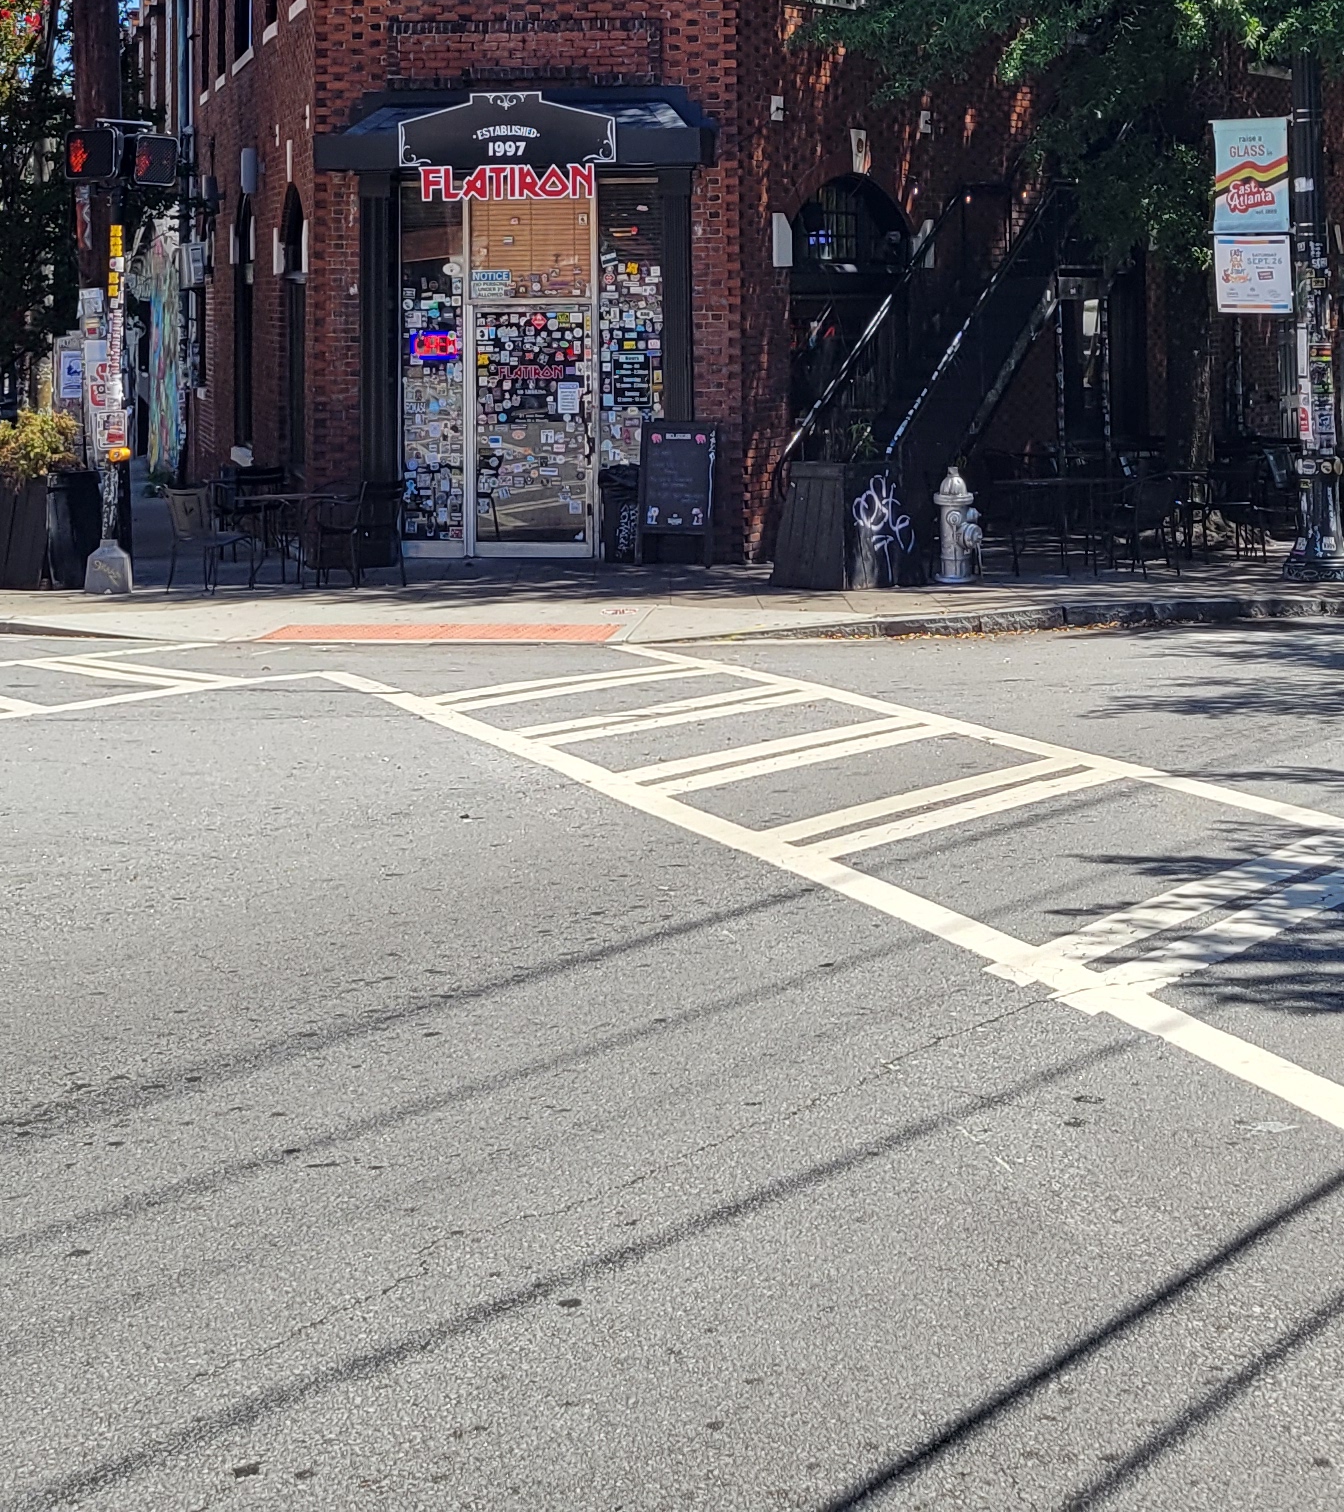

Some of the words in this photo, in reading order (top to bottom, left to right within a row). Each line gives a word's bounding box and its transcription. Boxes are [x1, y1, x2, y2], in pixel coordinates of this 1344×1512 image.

[476, 125, 537, 140] ESTABLISHED
[1238, 135, 1256, 143] raise
[488, 141, 526, 156] 1997
[1229, 144, 1265, 157] GLASS
[418, 163, 595, 201] FLATIRON
[1229, 179, 1257, 194] East
[1227, 191, 1273, 209] Atlanta
[1272, 257, 1283, 265] 26
[472, 272, 509, 281] NOTICE
[414, 335, 458, 355] OPEN
[497, 365, 564, 380] FLATIRON
